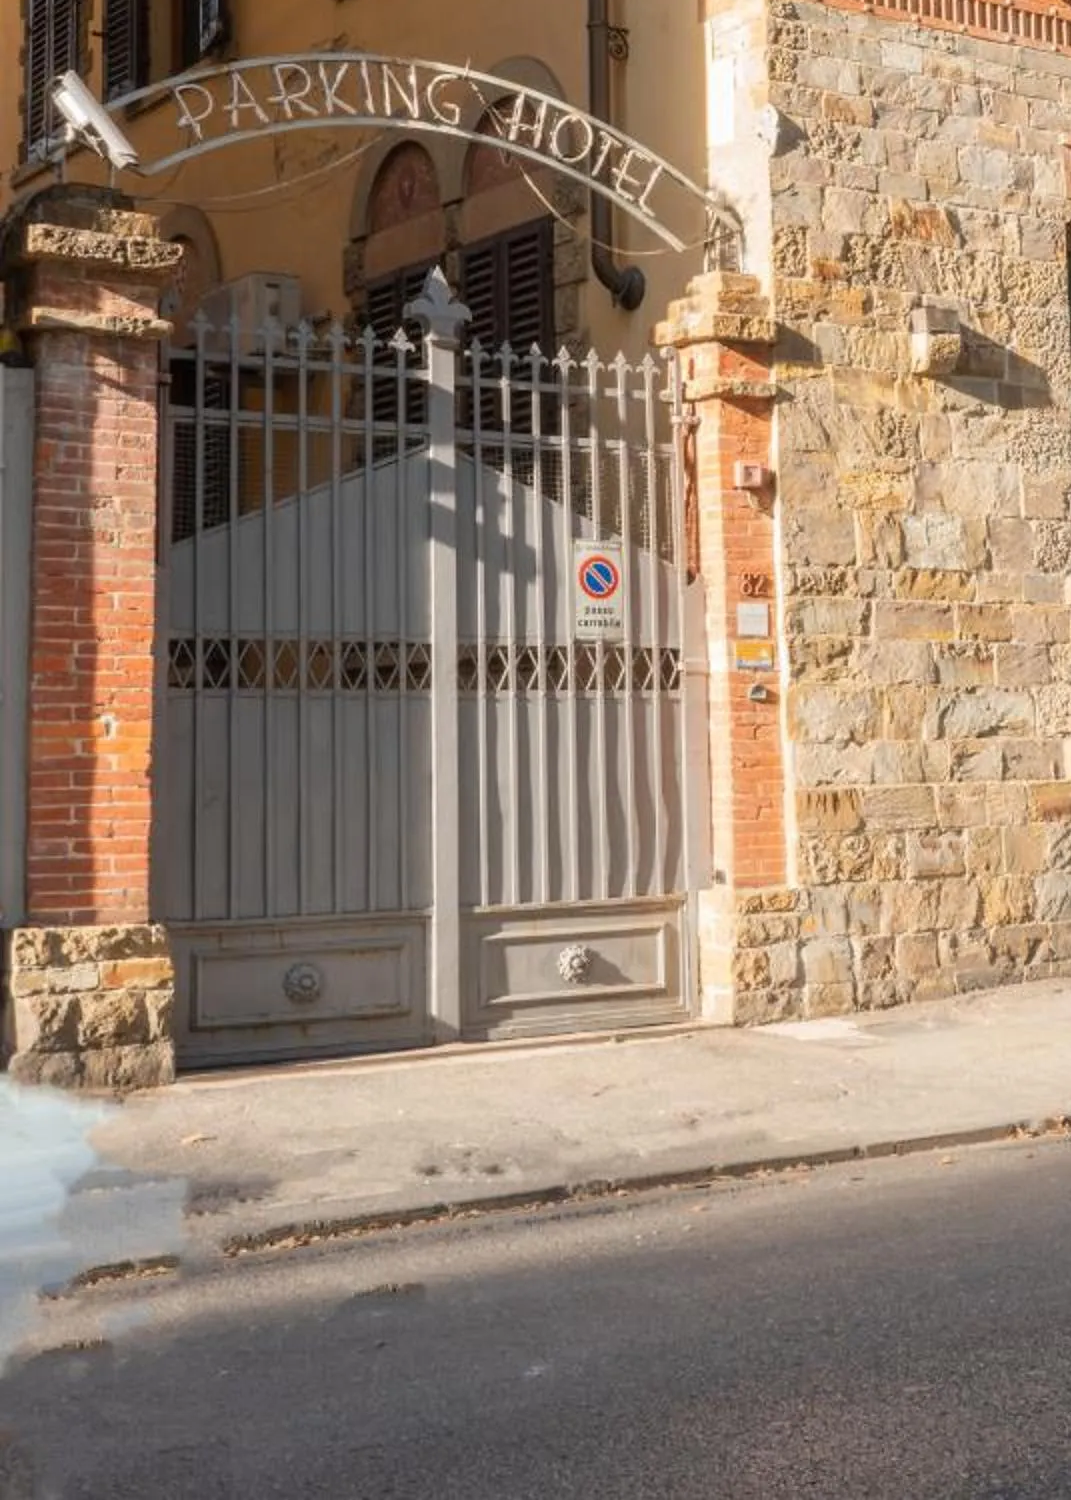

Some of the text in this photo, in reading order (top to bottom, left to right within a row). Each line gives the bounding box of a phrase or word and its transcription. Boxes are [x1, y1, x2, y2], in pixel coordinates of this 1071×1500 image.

[175, 62, 666, 218] PARKING HOTEL
[741, 572, 768, 596] 82
